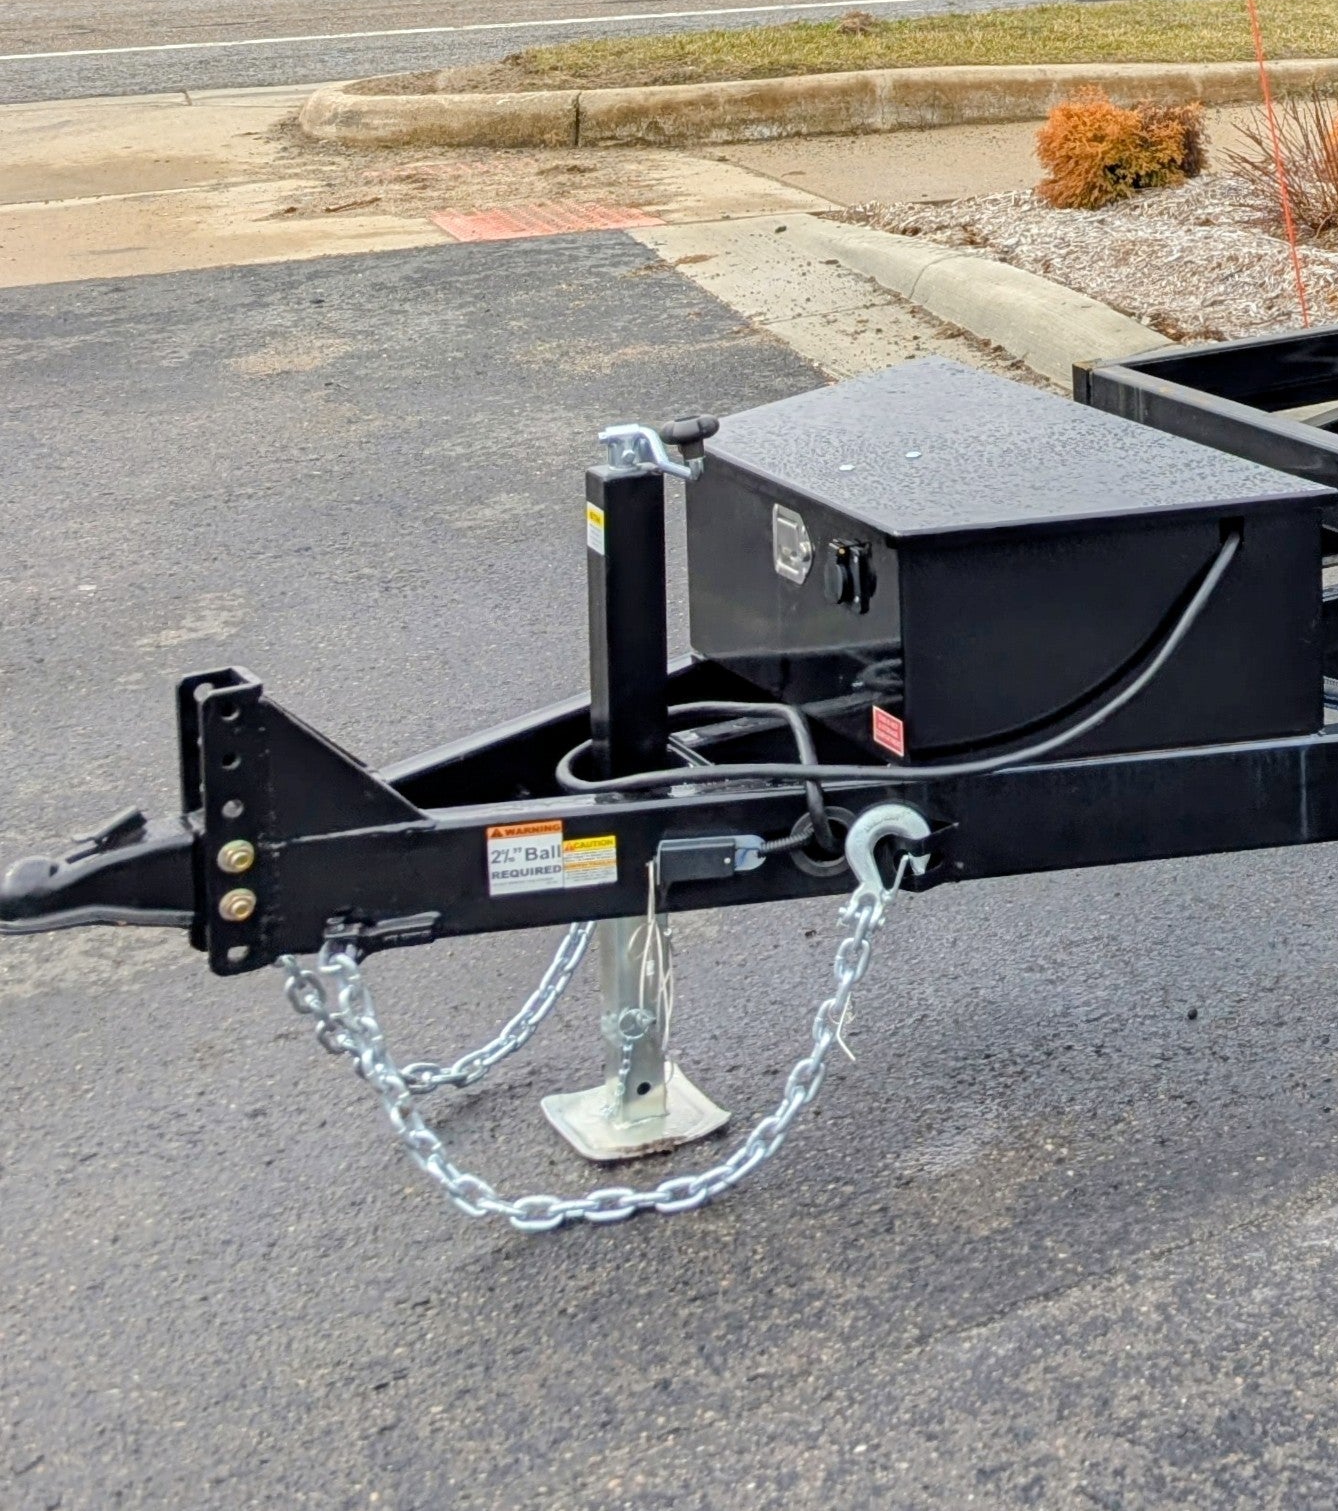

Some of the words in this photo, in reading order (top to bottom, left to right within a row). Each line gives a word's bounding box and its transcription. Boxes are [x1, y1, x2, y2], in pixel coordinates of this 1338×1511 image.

[505, 824, 561, 836] WARNING
[573, 839, 614, 849] CAUTION
[525, 844, 562, 862] Ball
[491, 864, 562, 880] REQUIRED
